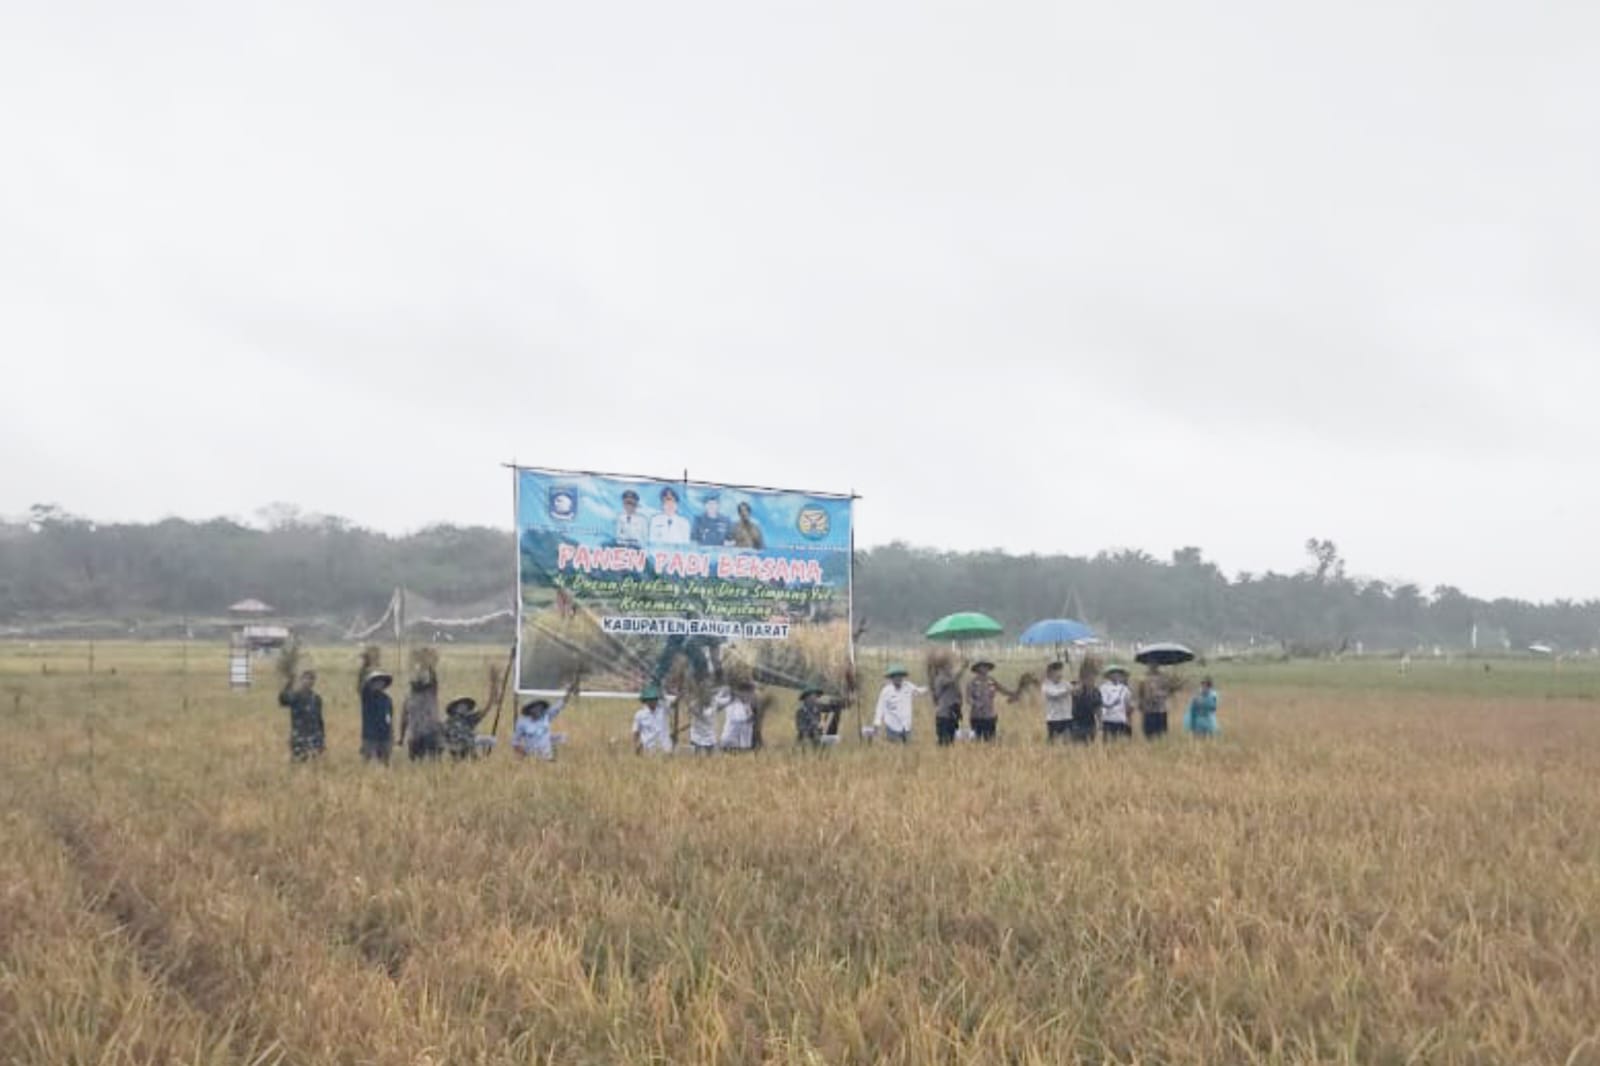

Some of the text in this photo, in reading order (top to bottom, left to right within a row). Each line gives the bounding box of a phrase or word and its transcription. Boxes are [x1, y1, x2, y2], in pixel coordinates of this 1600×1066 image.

[557, 542, 821, 585] PANEN PADI BERSAMA
[603, 618, 790, 638] KABUPATEN BANGKA BARAT
